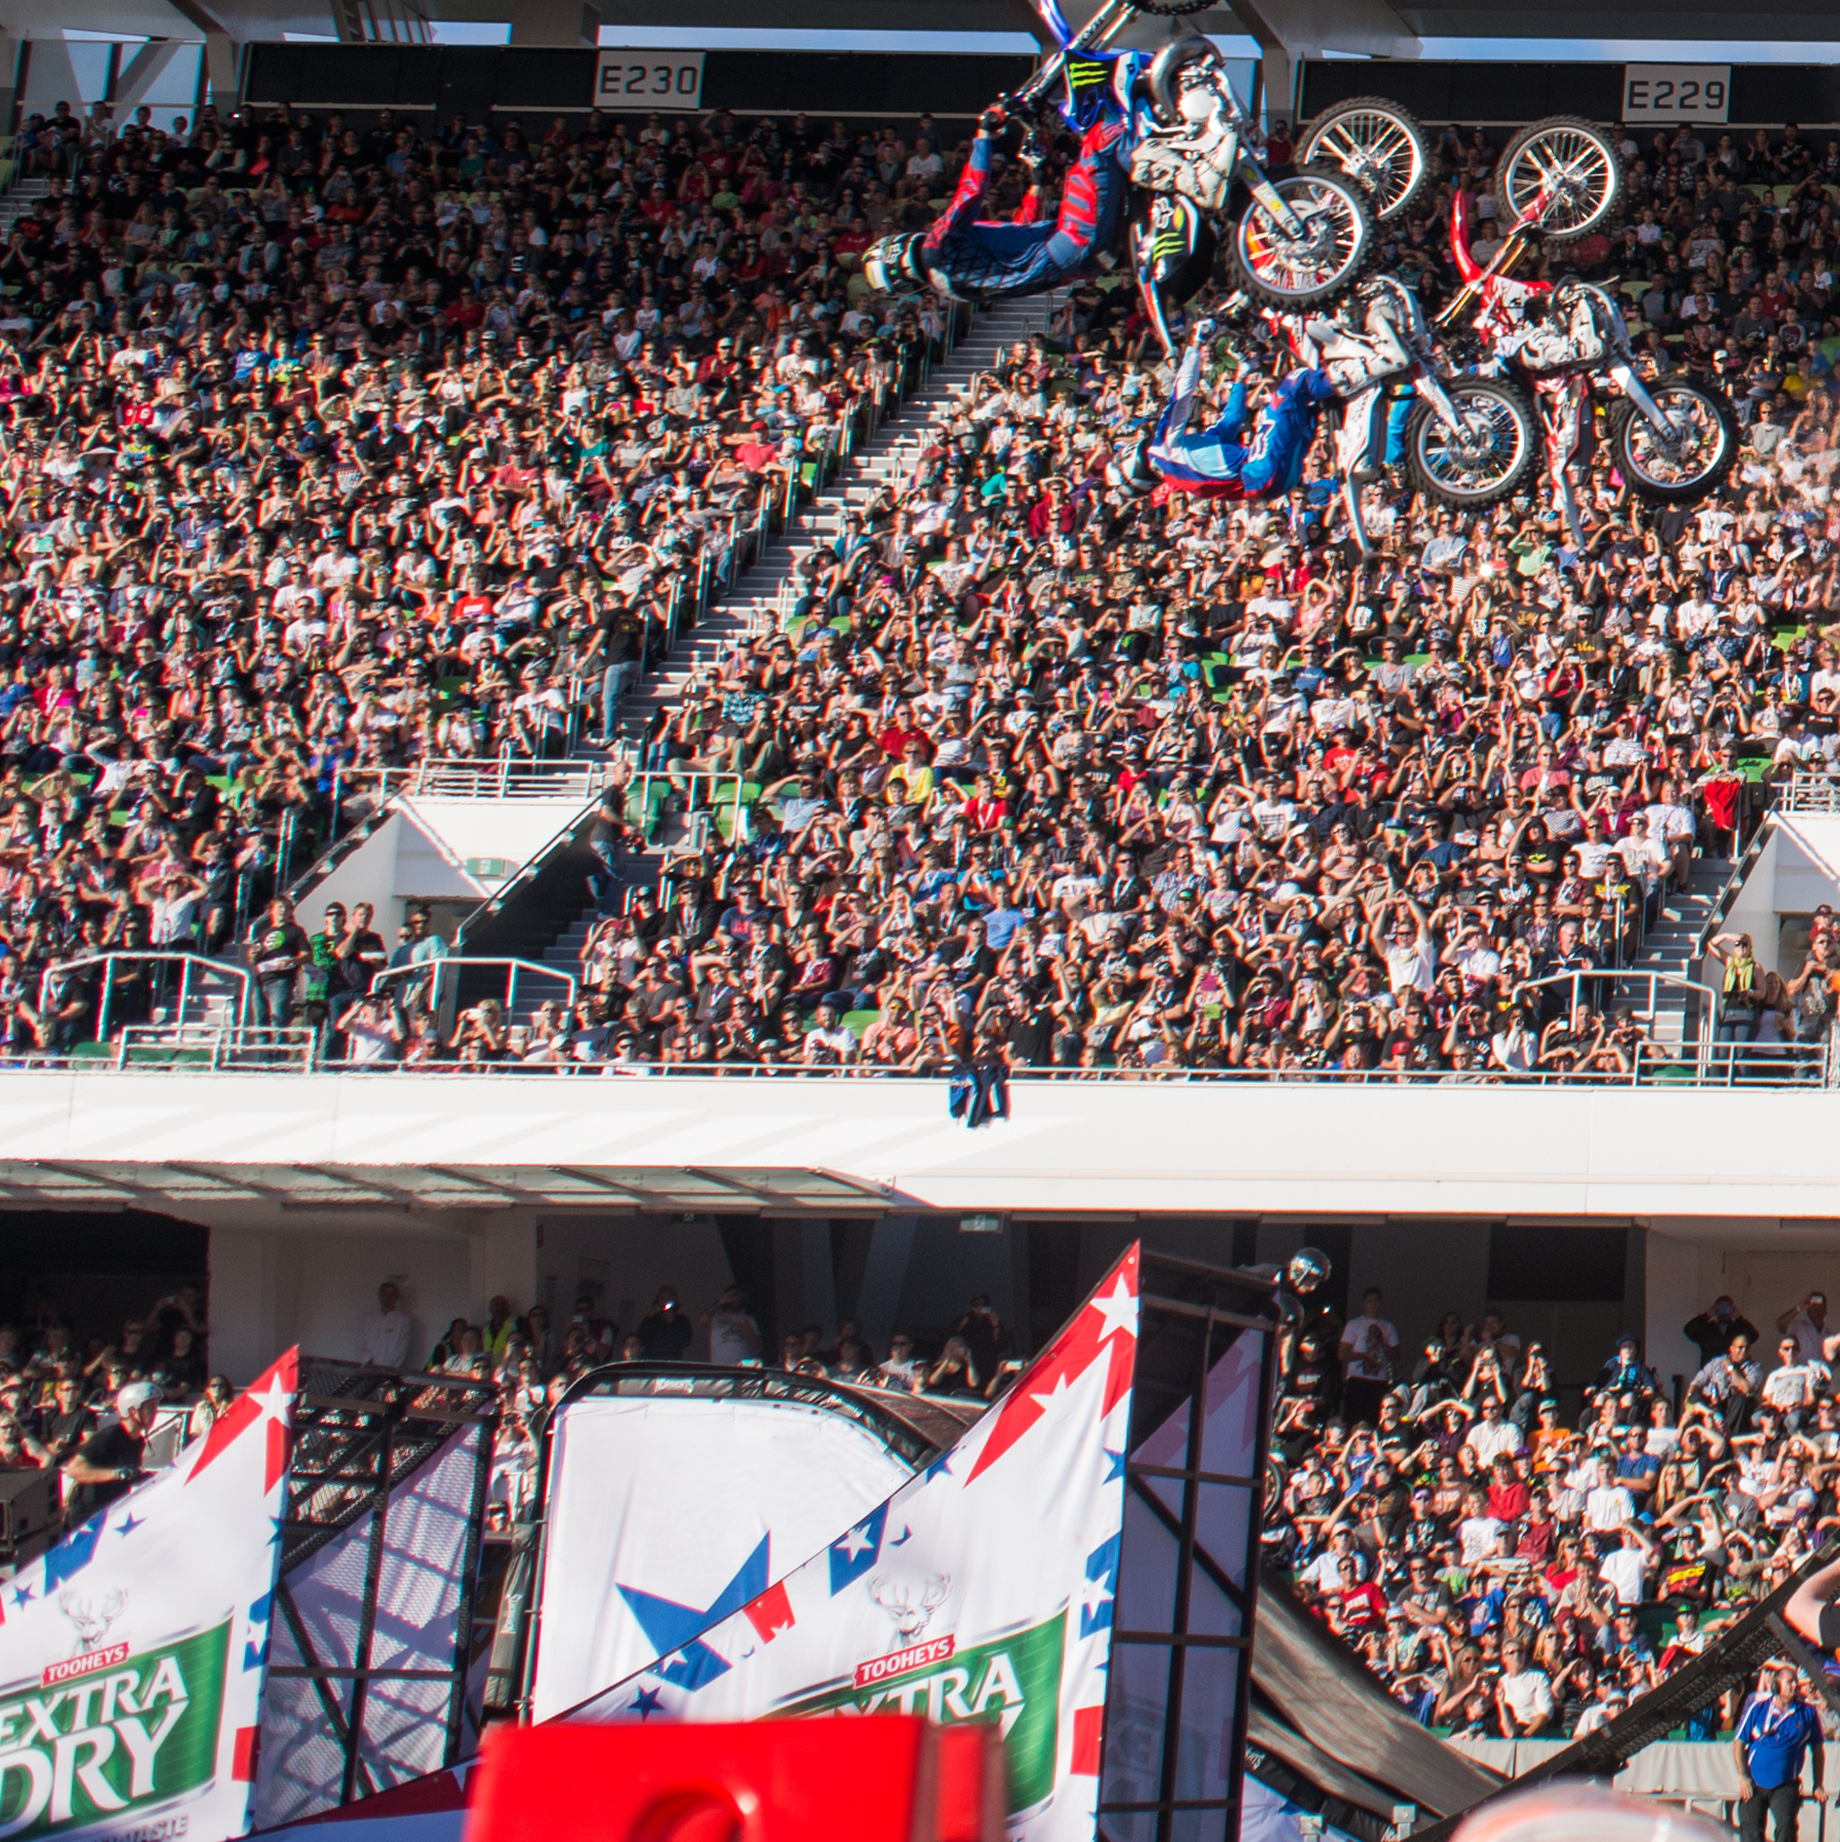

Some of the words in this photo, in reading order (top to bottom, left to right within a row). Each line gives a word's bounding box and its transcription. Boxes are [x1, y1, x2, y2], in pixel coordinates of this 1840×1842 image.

[600, 65, 699, 95] E230
[1627, 80, 1725, 109] E229
[47, 1647, 125, 1681] TOOHEYS
[860, 1637, 950, 1682] TOOHEYS
[0, 1655, 189, 1755] EXTRA
[812, 1652, 1024, 1725] TRA
[0, 1699, 190, 1840] DRY
